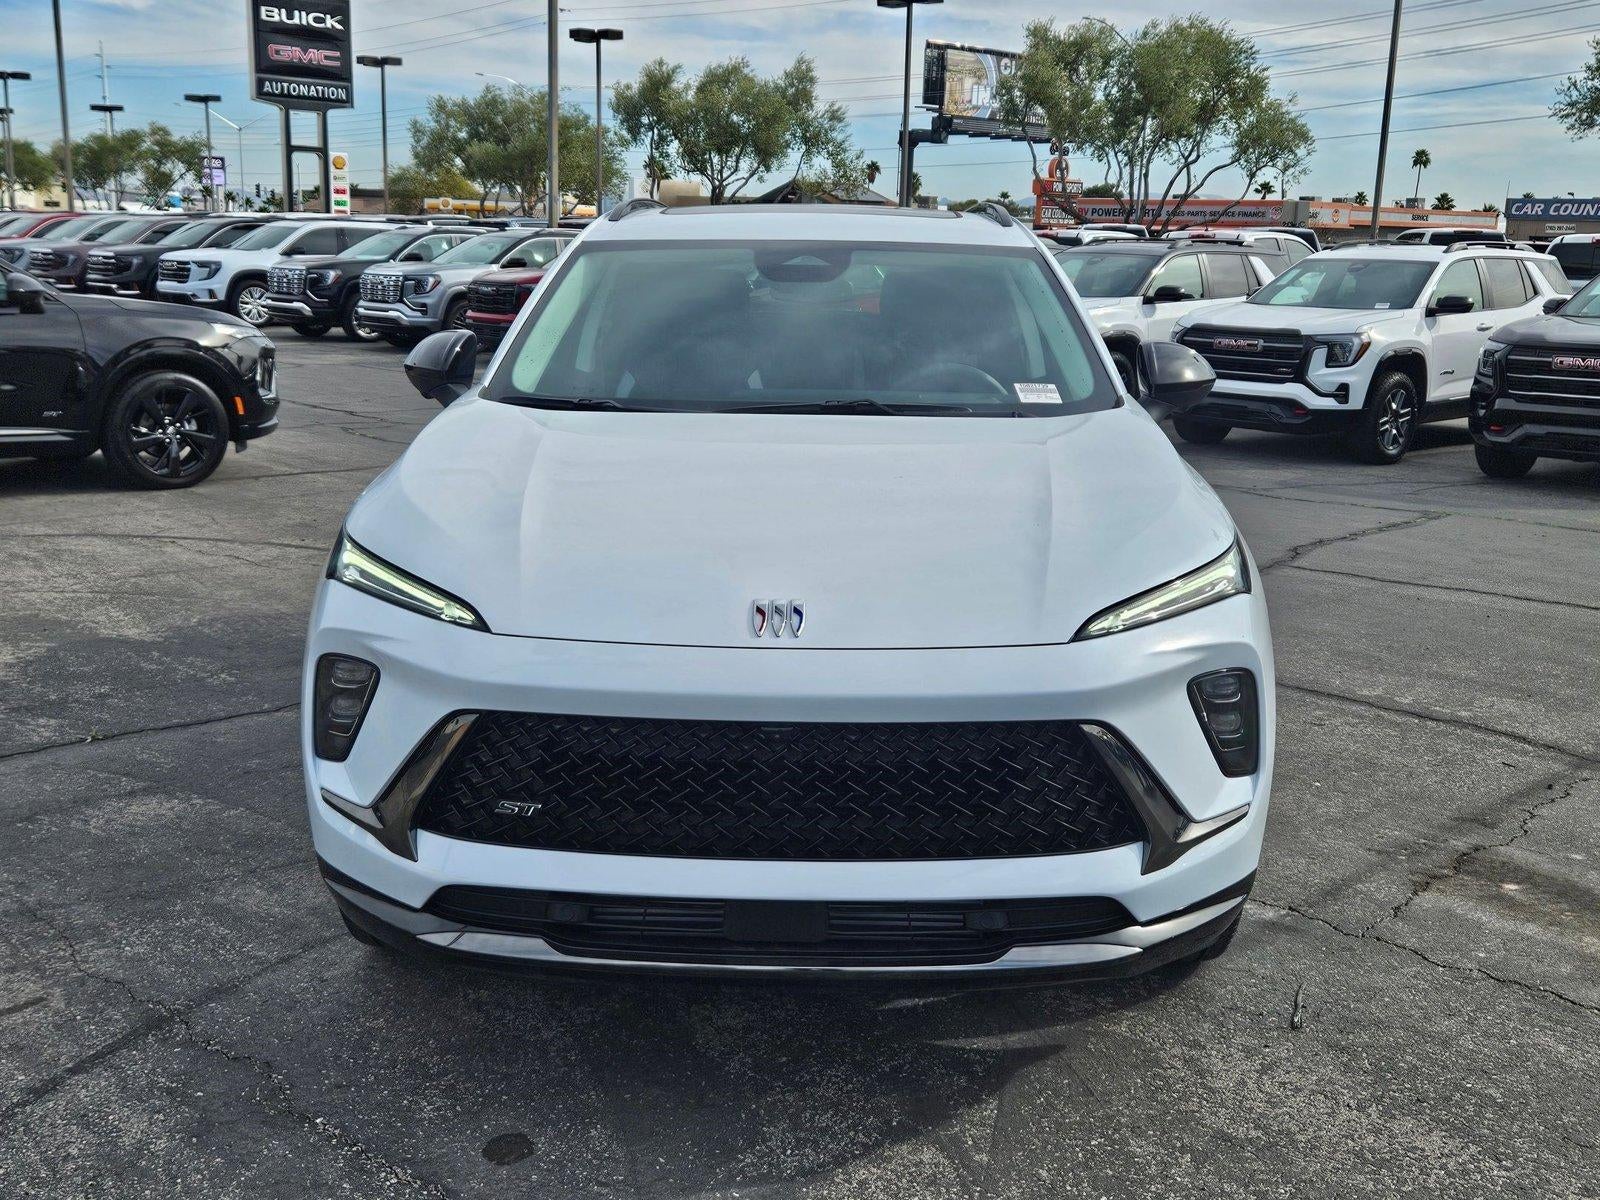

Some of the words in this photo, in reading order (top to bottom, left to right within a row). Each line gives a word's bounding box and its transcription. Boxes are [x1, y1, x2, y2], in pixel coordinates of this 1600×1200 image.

[260, 6, 345, 31] BUICK
[267, 43, 341, 66] GMC
[263, 80, 346, 100] AUTONATION
[1511, 203, 1544, 215] CAR
[1214, 338, 1261, 351] GMC
[494, 800, 542, 817] ST
